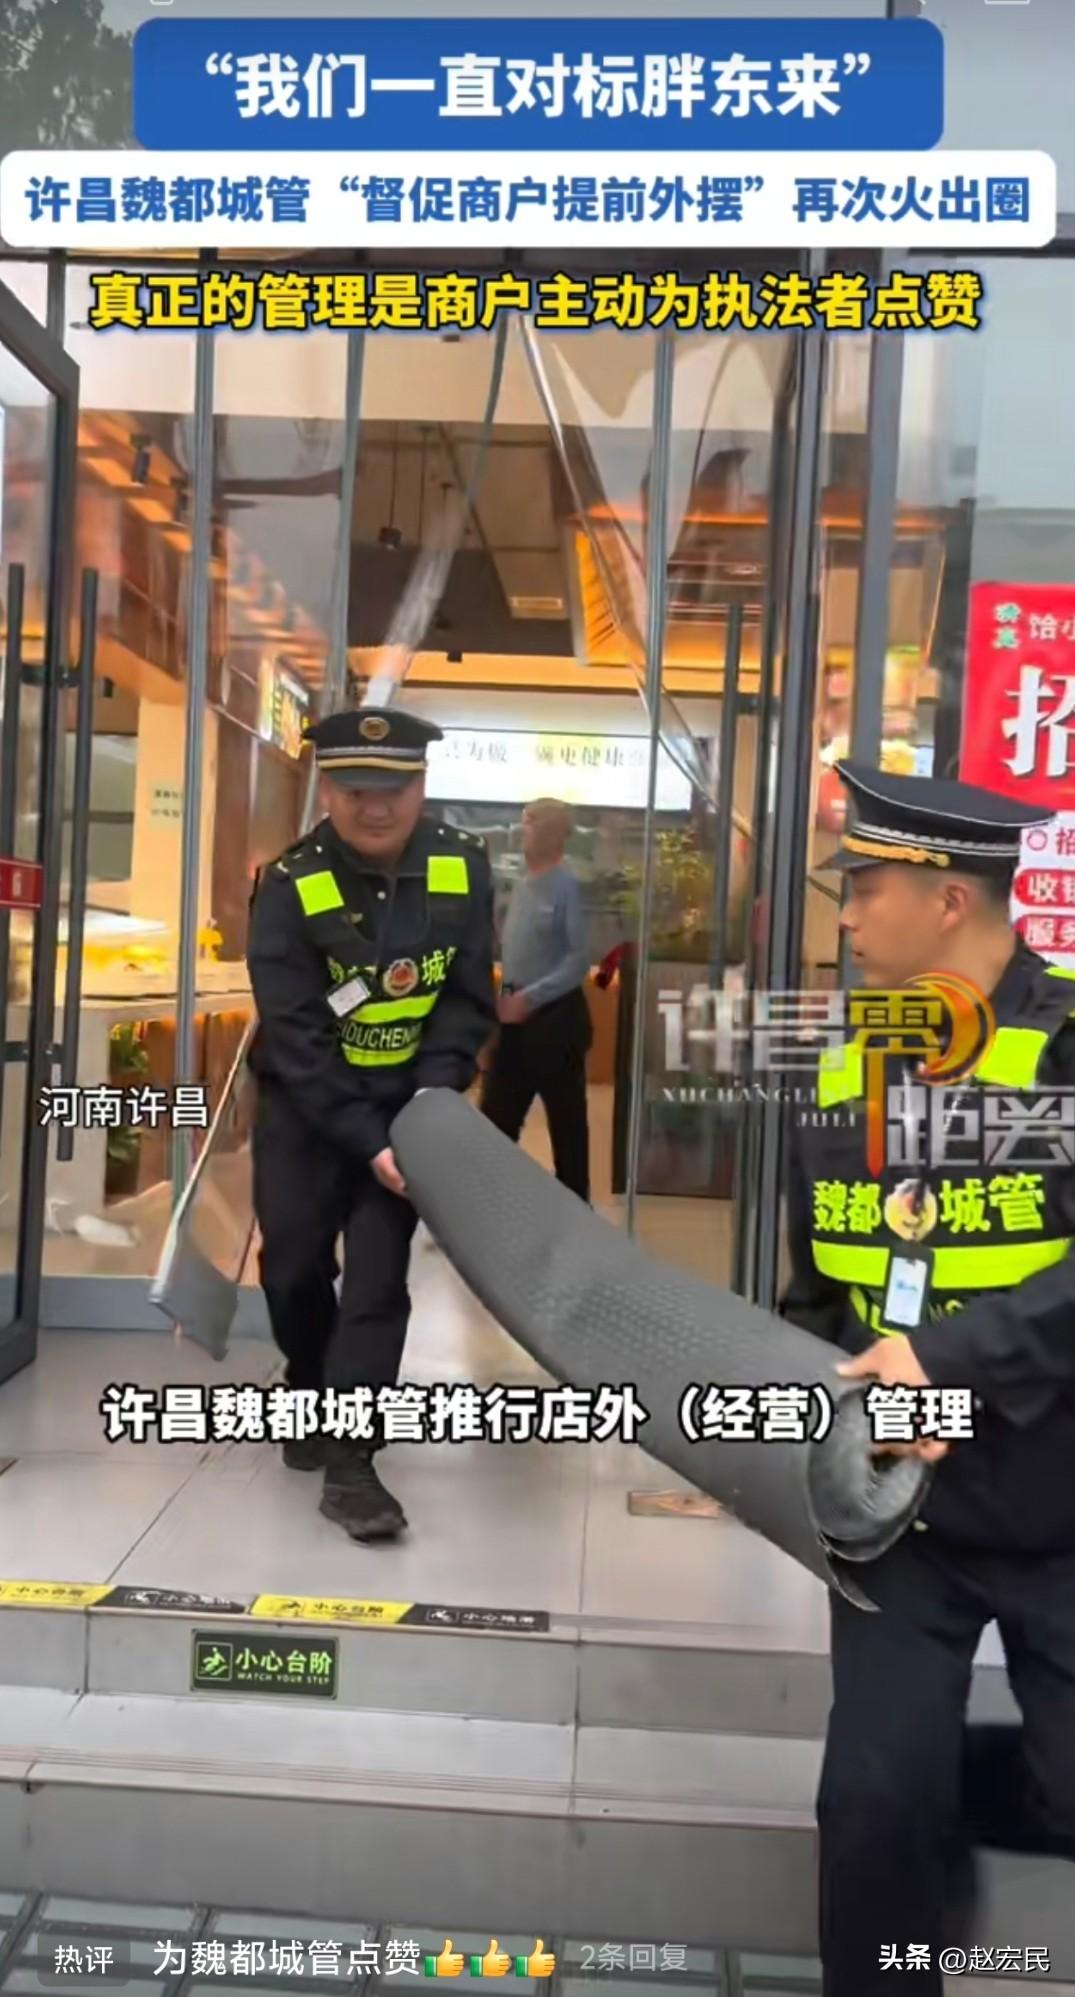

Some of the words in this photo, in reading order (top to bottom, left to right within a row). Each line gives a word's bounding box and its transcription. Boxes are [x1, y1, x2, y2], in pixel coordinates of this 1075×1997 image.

[235, 1648, 332, 1675] 小心台阶
[237, 1672, 272, 1681] WATCH
[277, 1675, 302, 1683] YOUR
[307, 1676, 330, 1685] STEP
